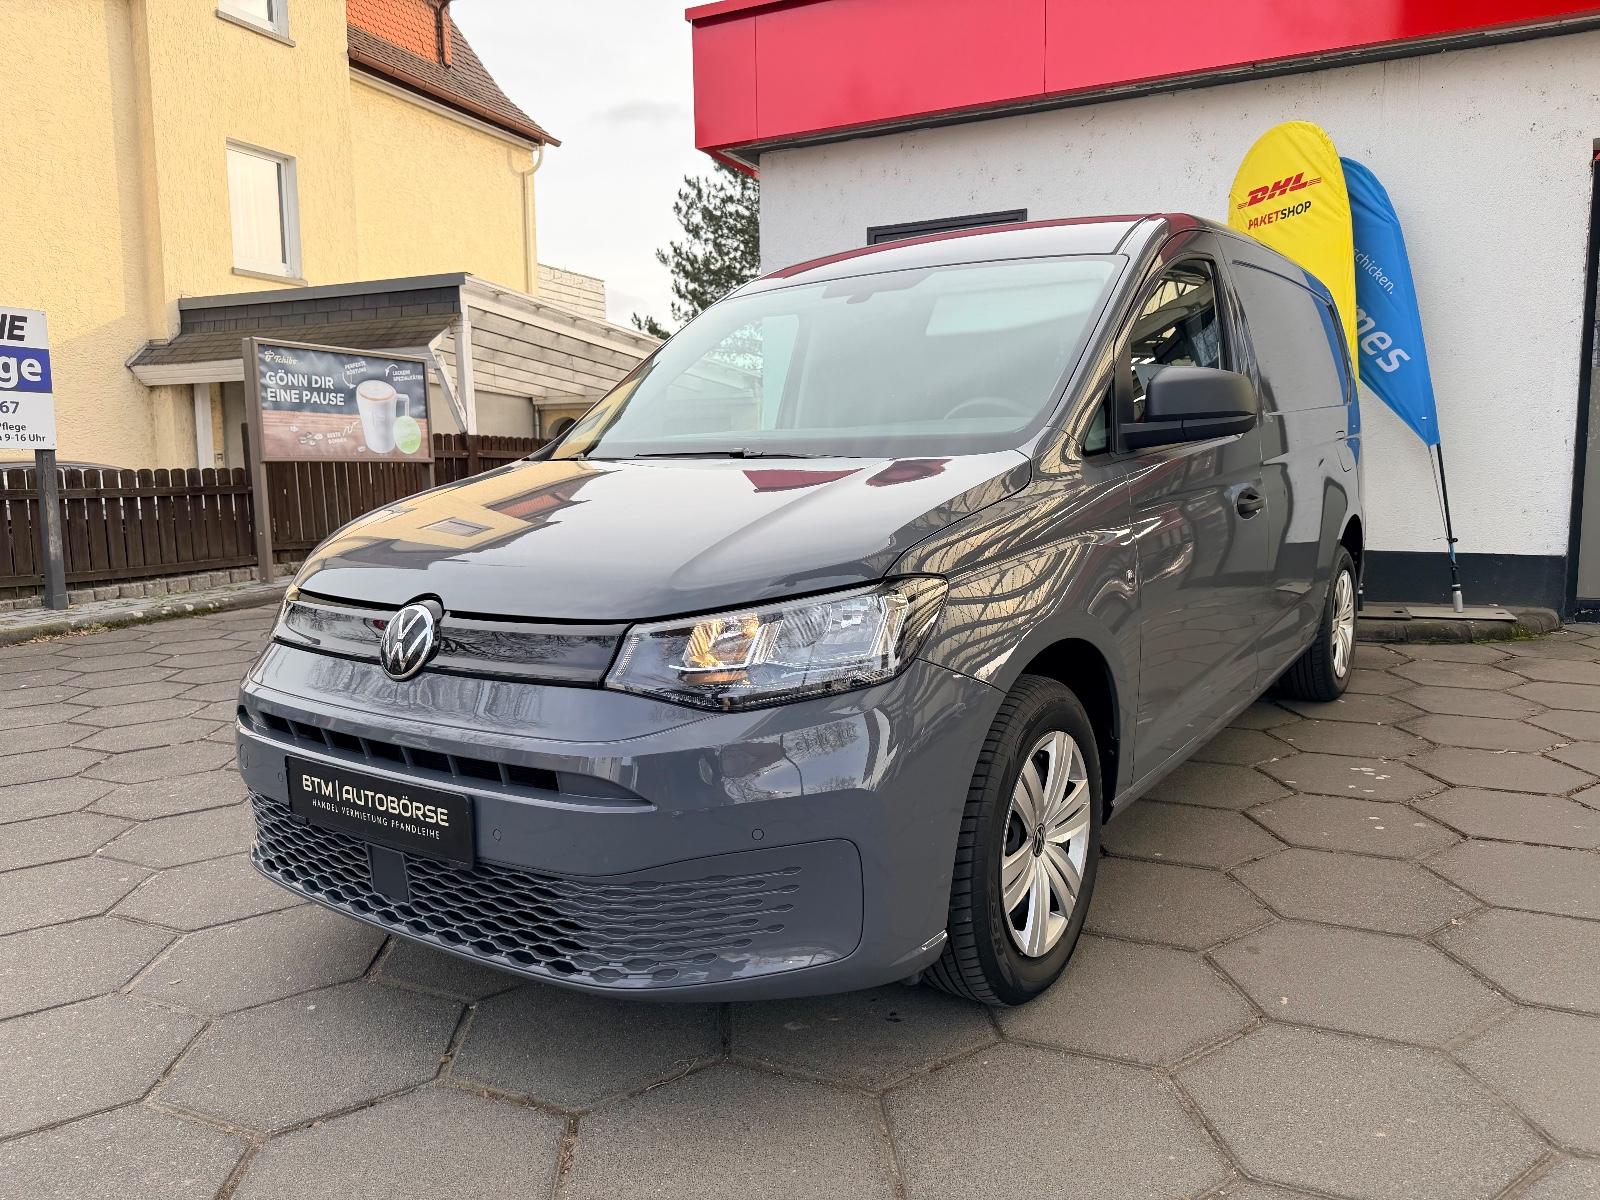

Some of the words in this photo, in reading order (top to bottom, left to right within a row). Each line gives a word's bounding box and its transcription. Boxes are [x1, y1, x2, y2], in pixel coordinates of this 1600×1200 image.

[1247, 172, 1309, 207] DHL
[1247, 200, 1312, 230] PAKETSHOP
[273, 355, 298, 365] Tchibo
[265, 369, 308, 387] GÖNN
[311, 375, 334, 389] DIR
[266, 388, 300, 403] EINE
[302, 390, 345, 406] PAUSE
[4, 433, 27, 442] 9-16
[28, 433, 46, 442] Uhr
[302, 774, 334, 798] BTM
[342, 785, 449, 827] AUTOBÖRSE
[312, 799, 339, 813] HANDEL
[341, 806, 388, 826] VERMIETUNG
[391, 819, 440, 840] PFANDLEIHE
